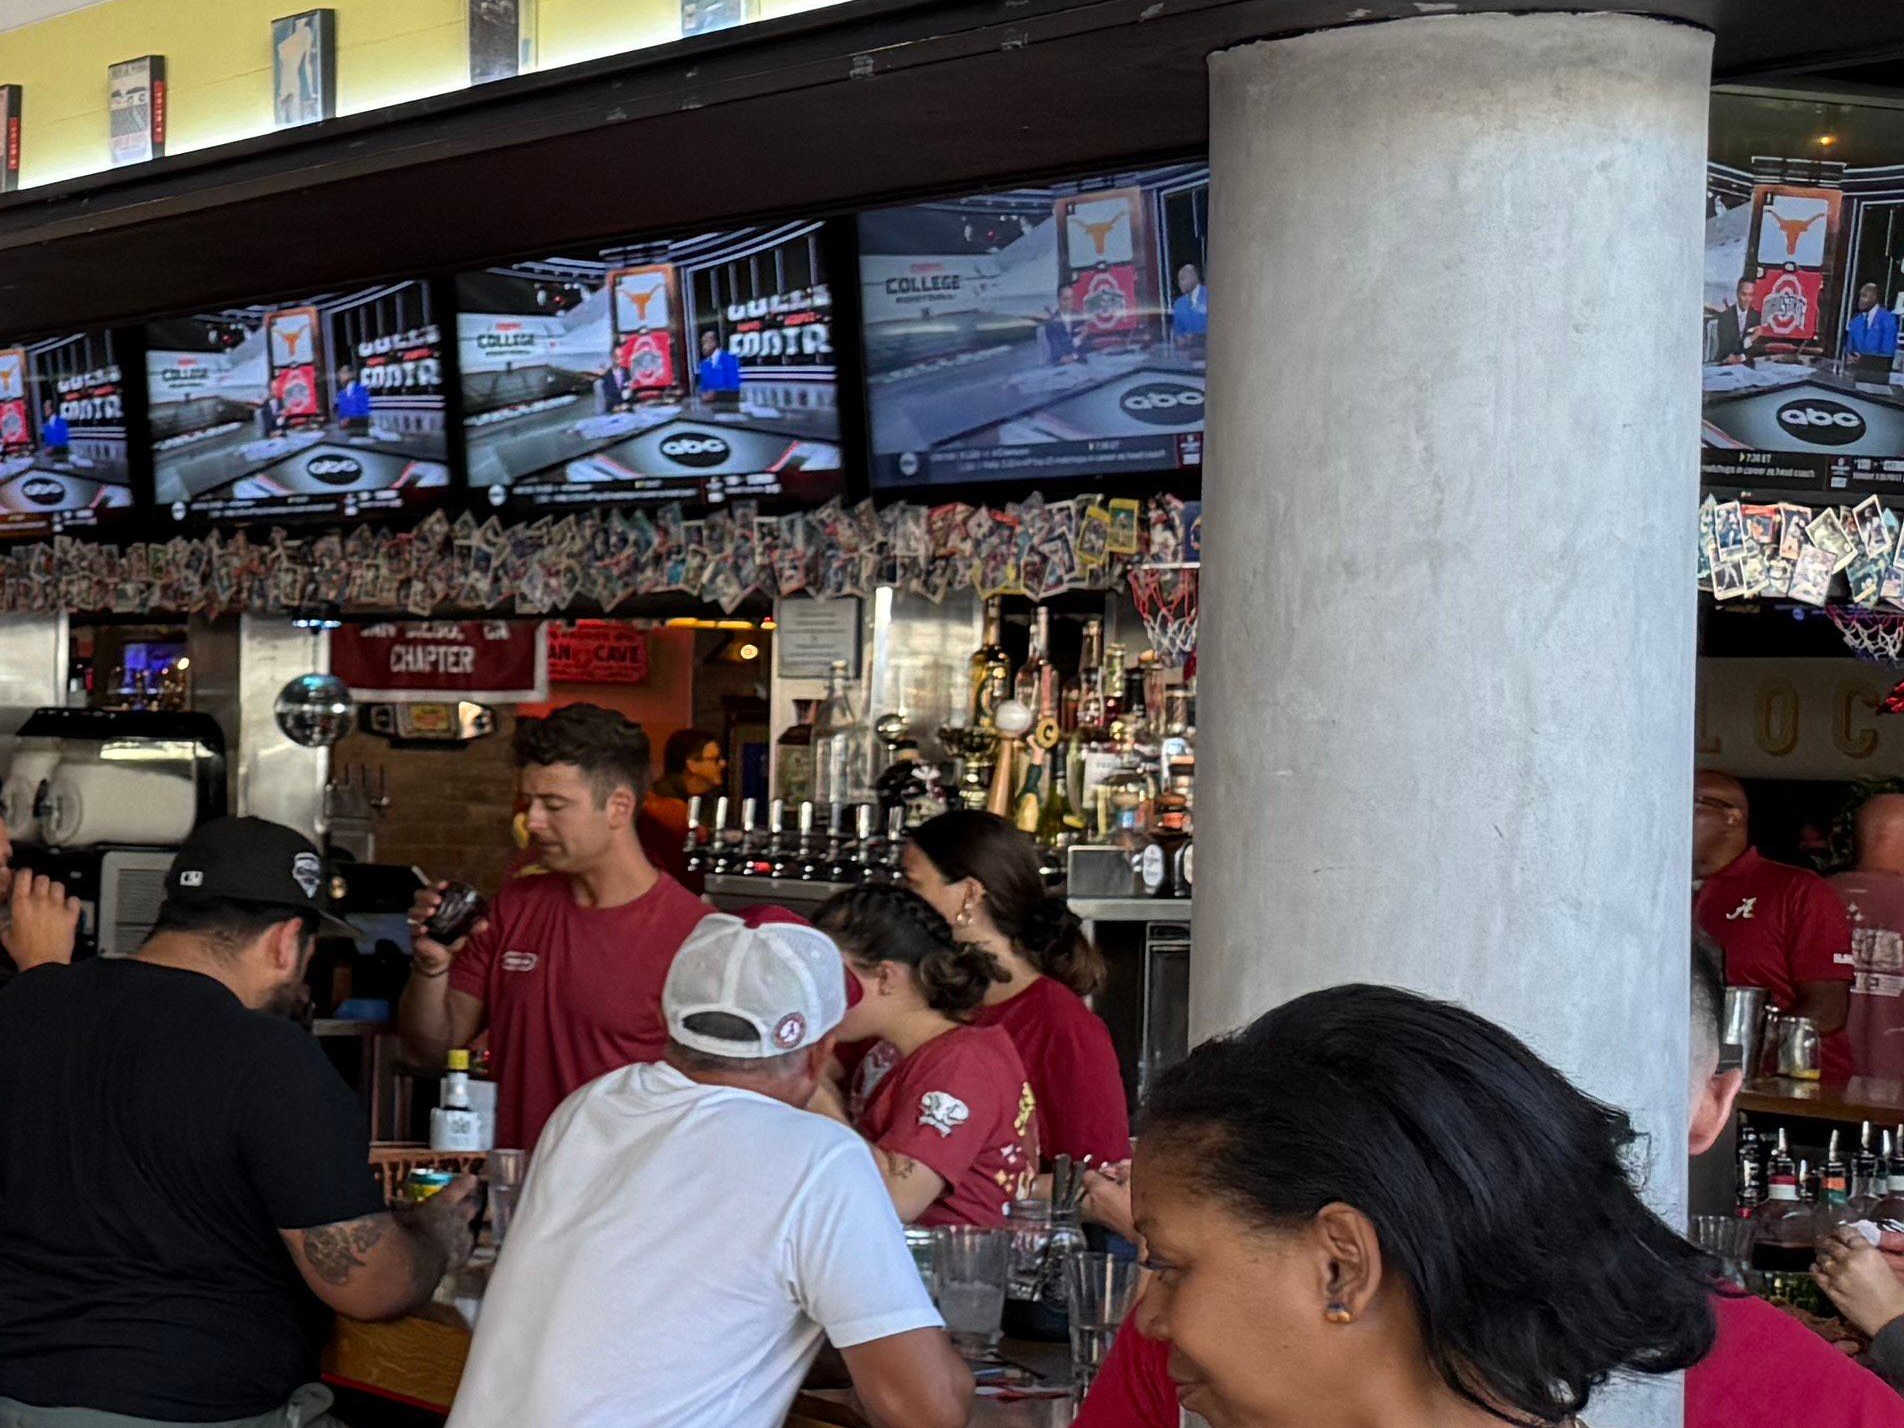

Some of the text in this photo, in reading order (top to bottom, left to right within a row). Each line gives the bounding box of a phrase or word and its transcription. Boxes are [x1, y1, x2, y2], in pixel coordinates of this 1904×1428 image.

[885, 274, 961, 295] COLLEGE
[1780, 407, 1861, 428] abc
[661, 437, 725, 455] abc
[390, 644, 475, 674] CHAPTER
[594, 644, 643, 666] CAVE
